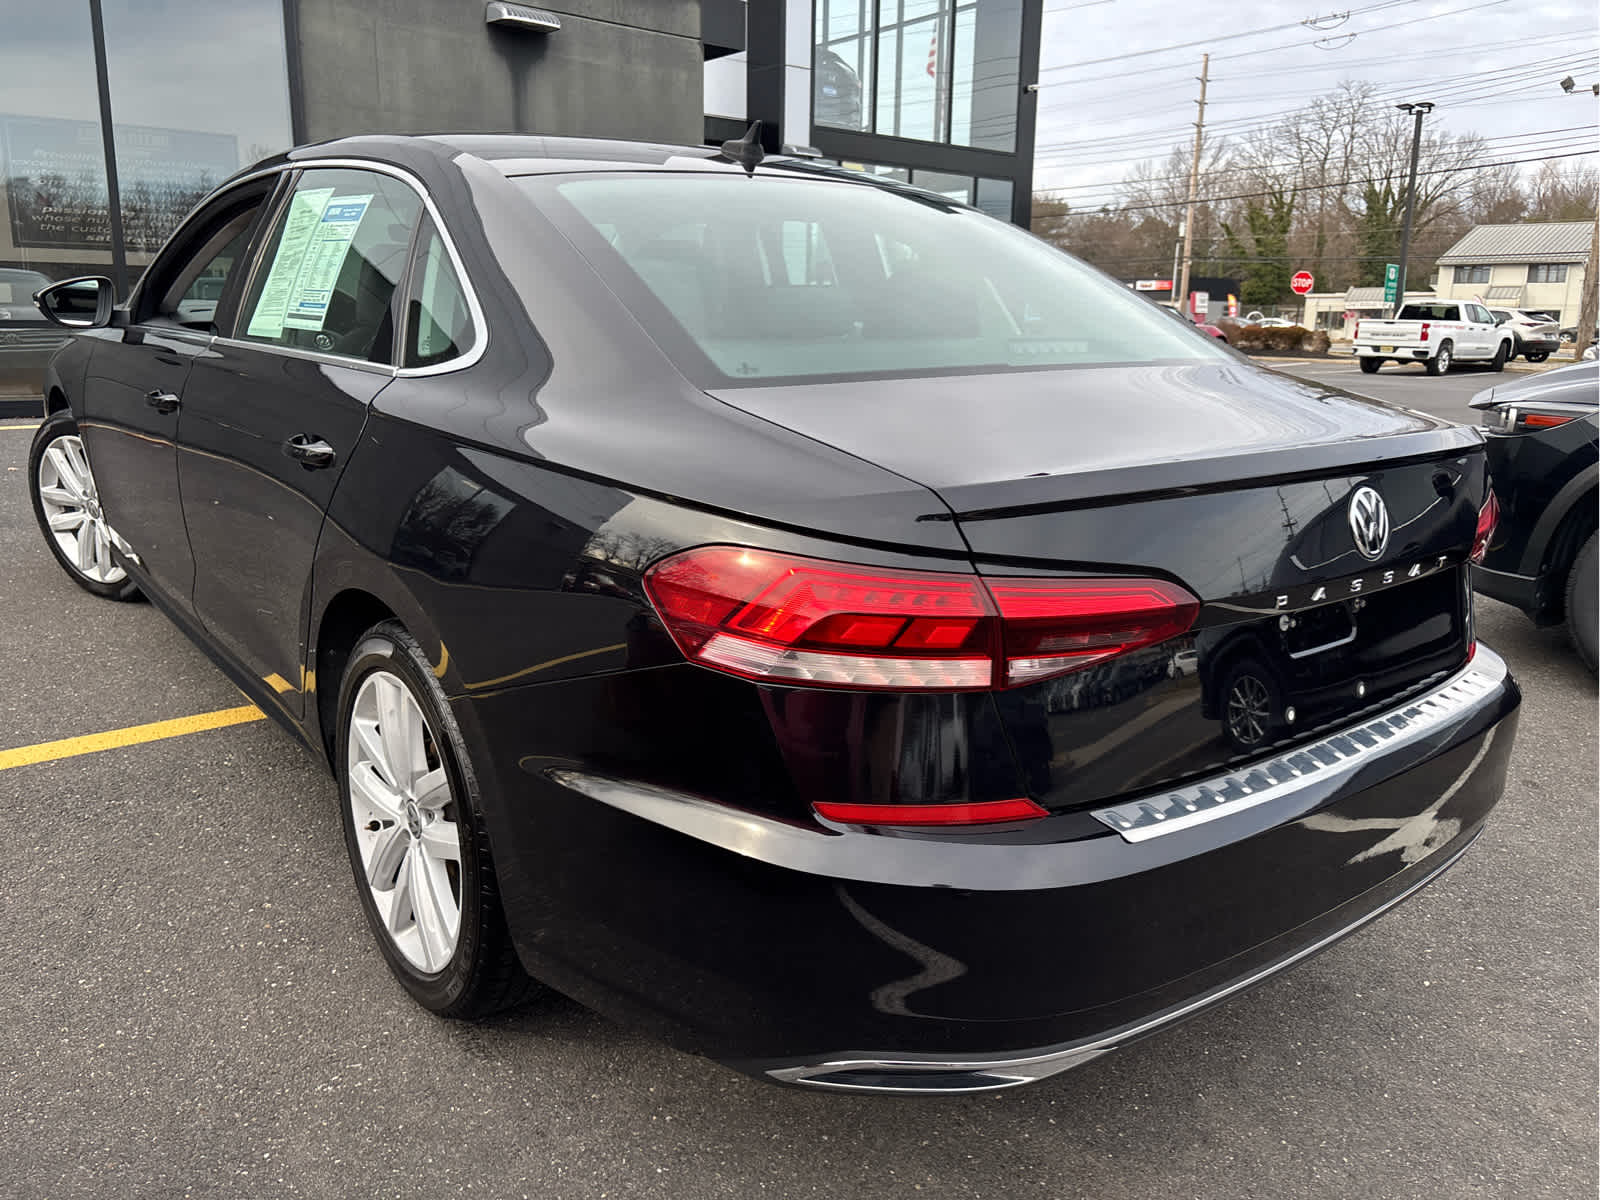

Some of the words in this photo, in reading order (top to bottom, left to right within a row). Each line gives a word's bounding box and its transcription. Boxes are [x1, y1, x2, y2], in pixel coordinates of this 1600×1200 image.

[40, 223, 65, 231] the
[1292, 277, 1313, 288] STOP
[1275, 555, 1448, 610] PASSAT
